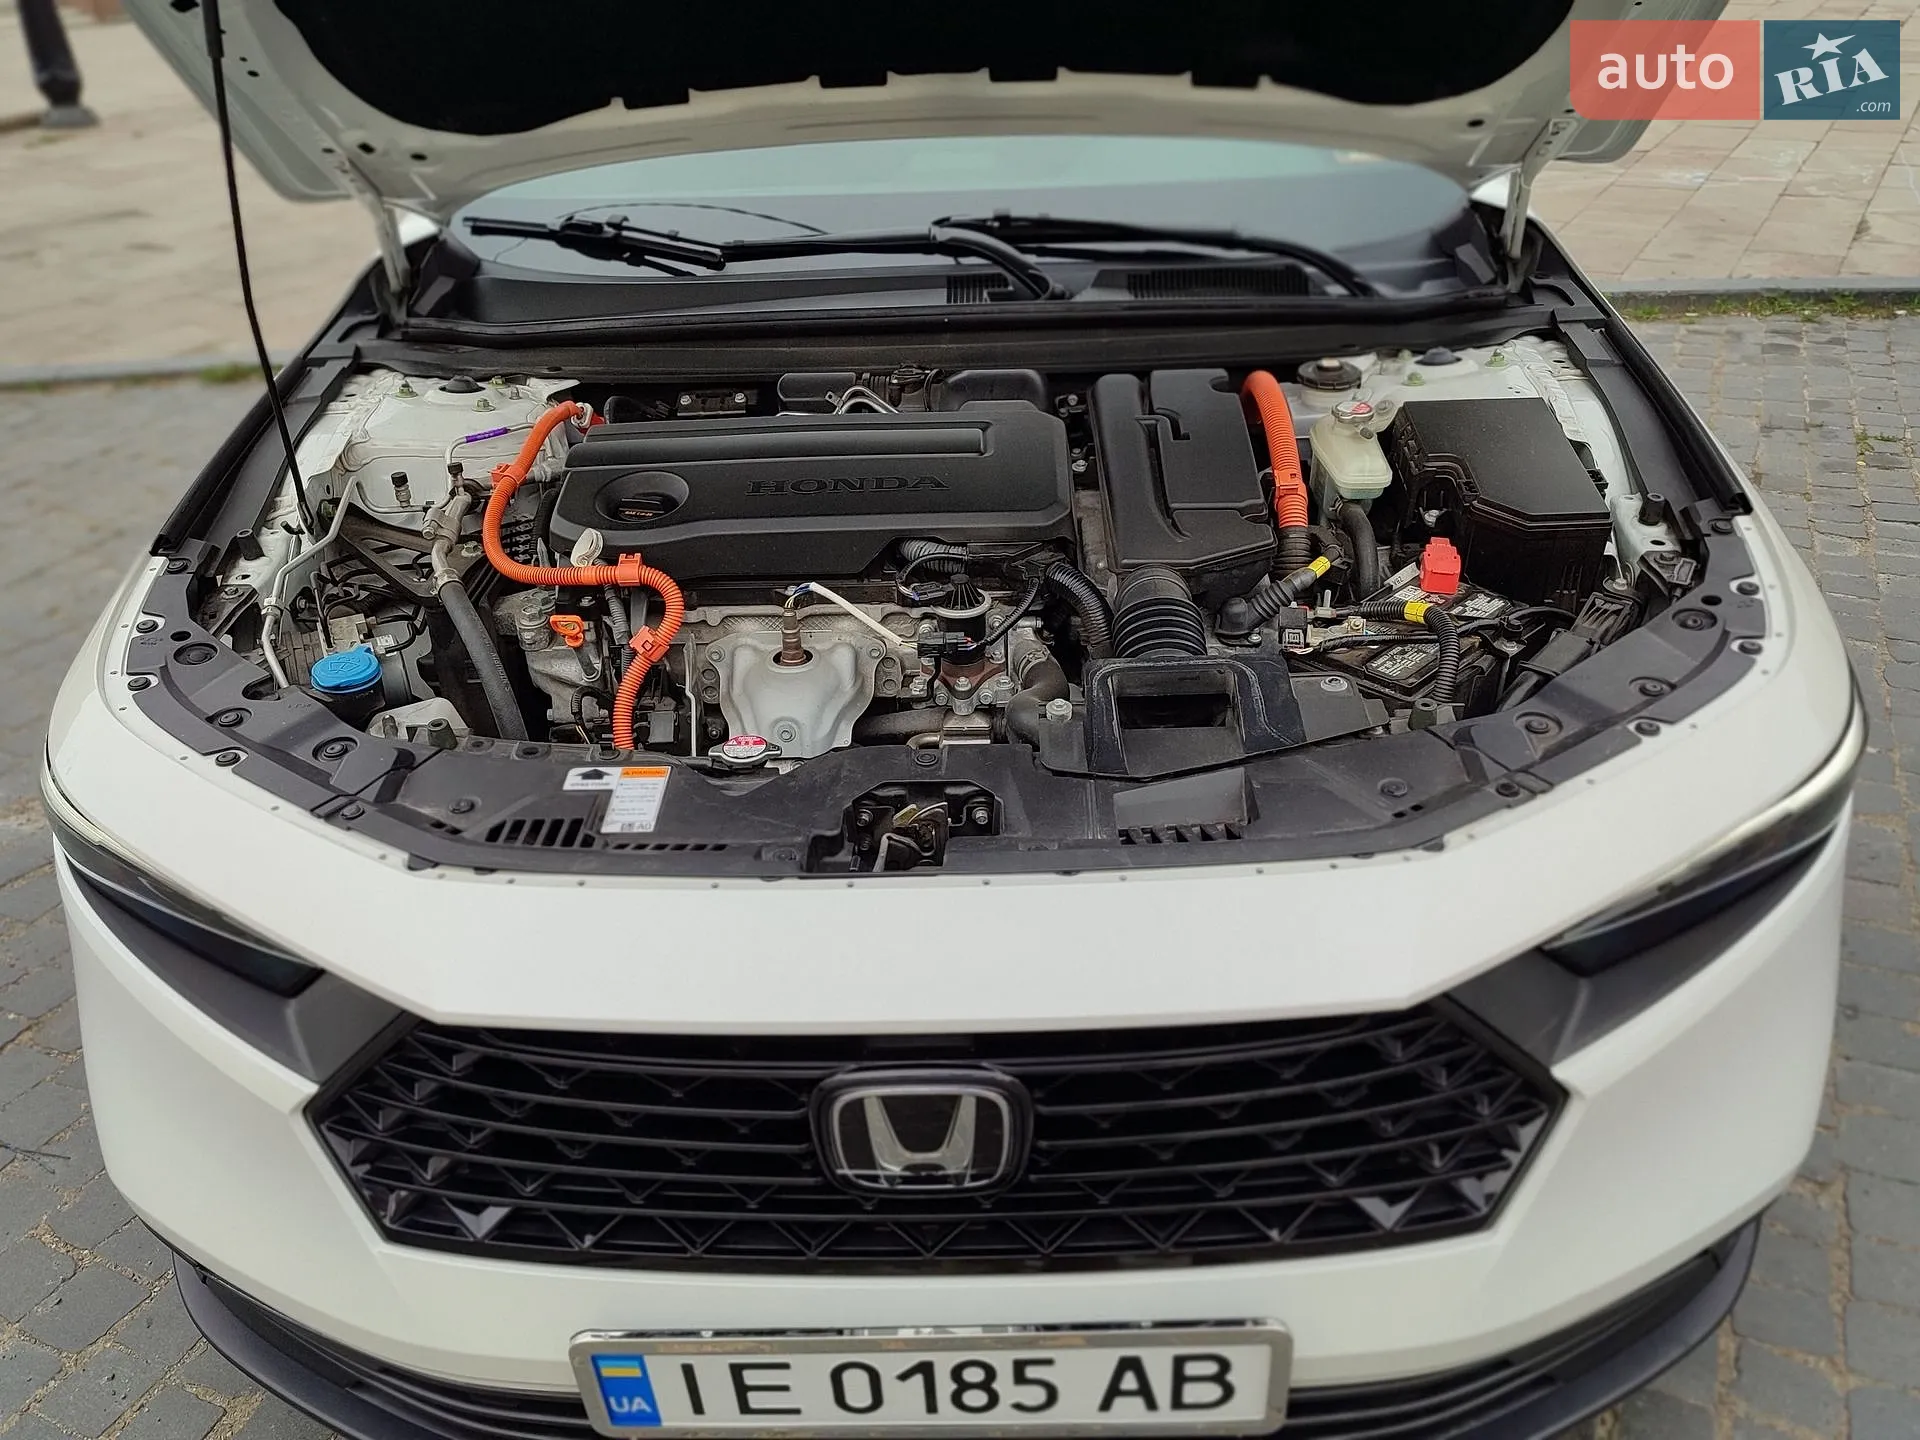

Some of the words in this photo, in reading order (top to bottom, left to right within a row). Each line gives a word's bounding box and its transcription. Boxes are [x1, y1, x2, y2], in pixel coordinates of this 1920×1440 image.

[745, 476, 950, 495] HONDA
[680, 1361, 802, 1415] IE
[829, 1357, 1060, 1415] 0185
[1098, 1352, 1236, 1412] AB
[609, 1396, 652, 1413] UA
